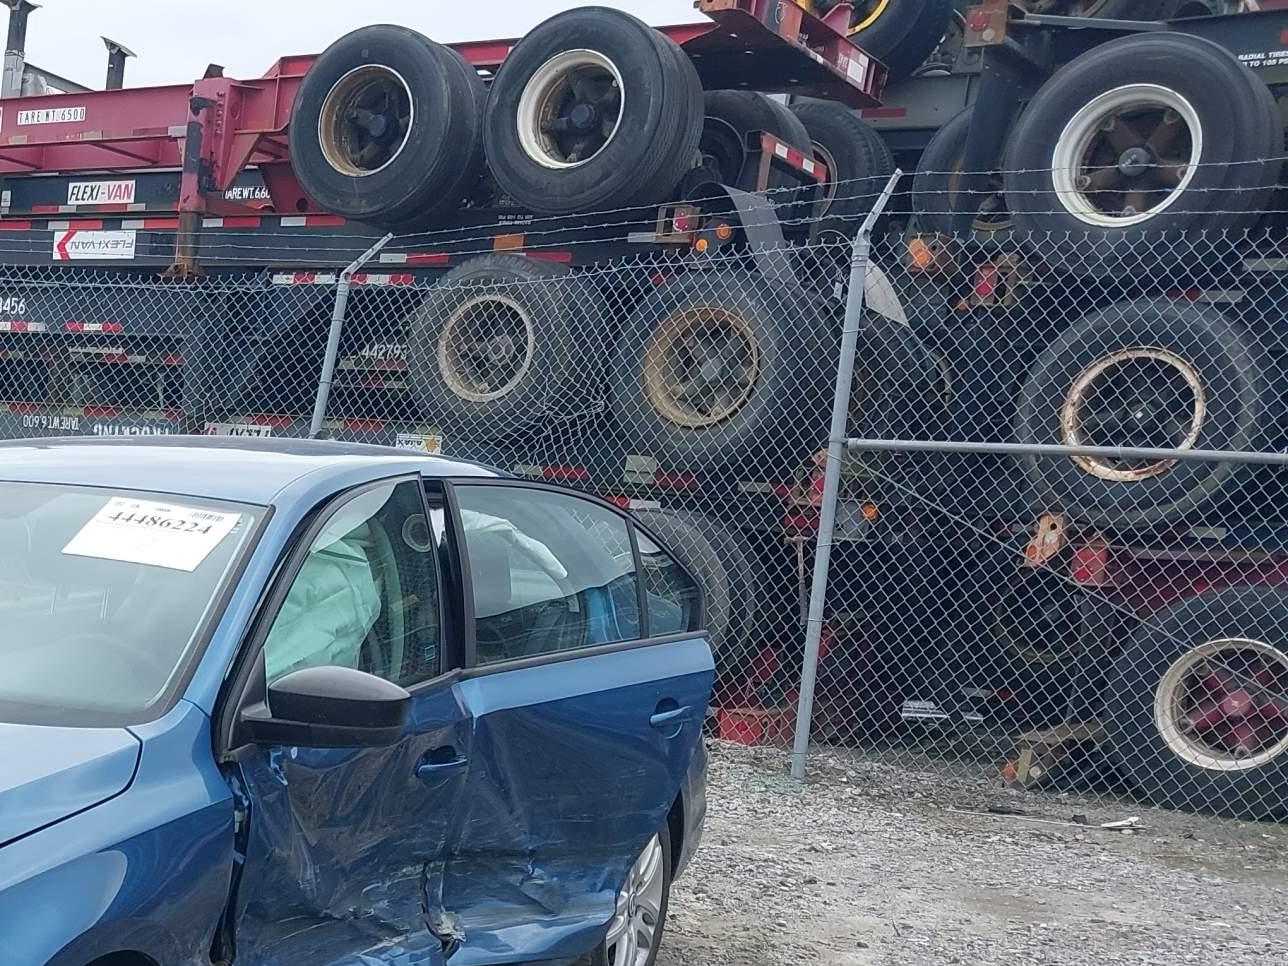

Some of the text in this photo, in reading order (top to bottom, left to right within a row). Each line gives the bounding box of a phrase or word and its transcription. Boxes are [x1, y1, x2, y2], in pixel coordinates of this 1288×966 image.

[19, 111, 40, 124] TARE
[61, 108, 85, 121] 6500
[69, 183, 133, 201] FLEXI-VAN
[109, 511, 212, 534] 44486224
